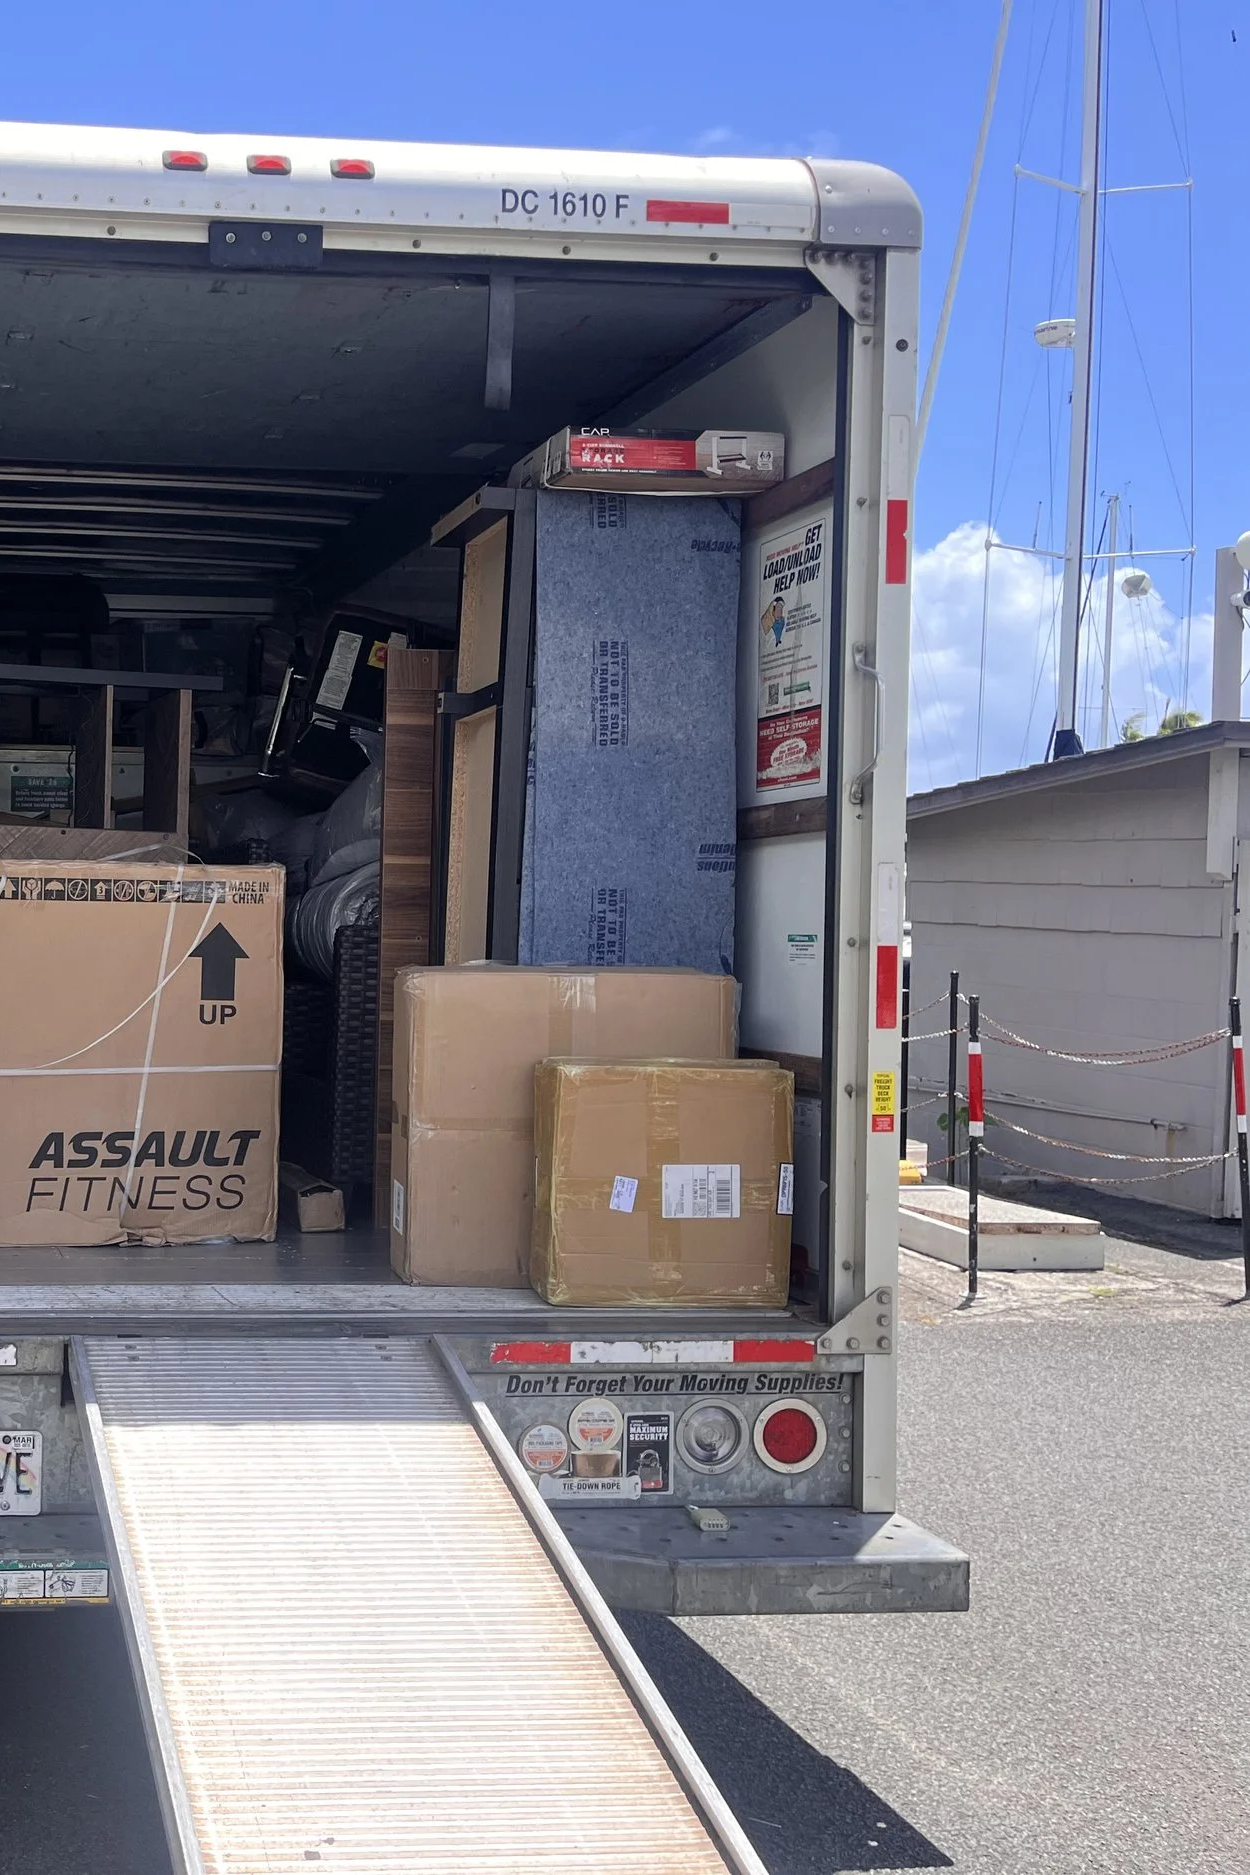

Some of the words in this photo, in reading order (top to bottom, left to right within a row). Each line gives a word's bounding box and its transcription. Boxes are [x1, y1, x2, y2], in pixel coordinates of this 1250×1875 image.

[501, 188, 539, 214] DC
[549, 191, 607, 218] 1610
[615, 194, 630, 219] F
[581, 427, 610, 436] CAP
[582, 453, 624, 464] RACK
[608, 497, 617, 527] SOLD
[805, 524, 822, 546] GET
[763, 543, 822, 580] LOAD/UNLOAD
[773, 572, 796, 594] HELP
[796, 562, 820, 587] NOW!
[600, 641, 608, 656] OR
[610, 641, 619, 666] NOT
[610, 673, 619, 687] TO
[599, 662, 608, 746] TRANSFERRED
[610, 693, 619, 708] BE
[610, 713, 619, 746] SOLD
[229, 881, 257, 892] MADE
[259, 882, 270, 892] IN
[232, 893, 264, 904] CHINA
[598, 888, 606, 904] OR
[608, 888, 617, 914] NOT
[608, 920, 617, 934] TO
[607, 940, 616, 956] BE
[200, 1004, 238, 1025] UP
[28, 1130, 262, 1169] ASSAULT
[25, 1174, 246, 1212] FITNESS
[506, 1374, 559, 1394] Don't
[564, 1375, 627, 1396] Forget
[634, 1375, 675, 1392] Your
[680, 1374, 749, 1394] Moving
[754, 1373, 845, 1394] Supplies!
[630, 1426, 668, 1434] MAXIMUM
[13, 1436, 32, 1444] MAR
[563, 1482, 600, 1490] TIE-DOWN
[601, 1482, 621, 1490] ROPE
